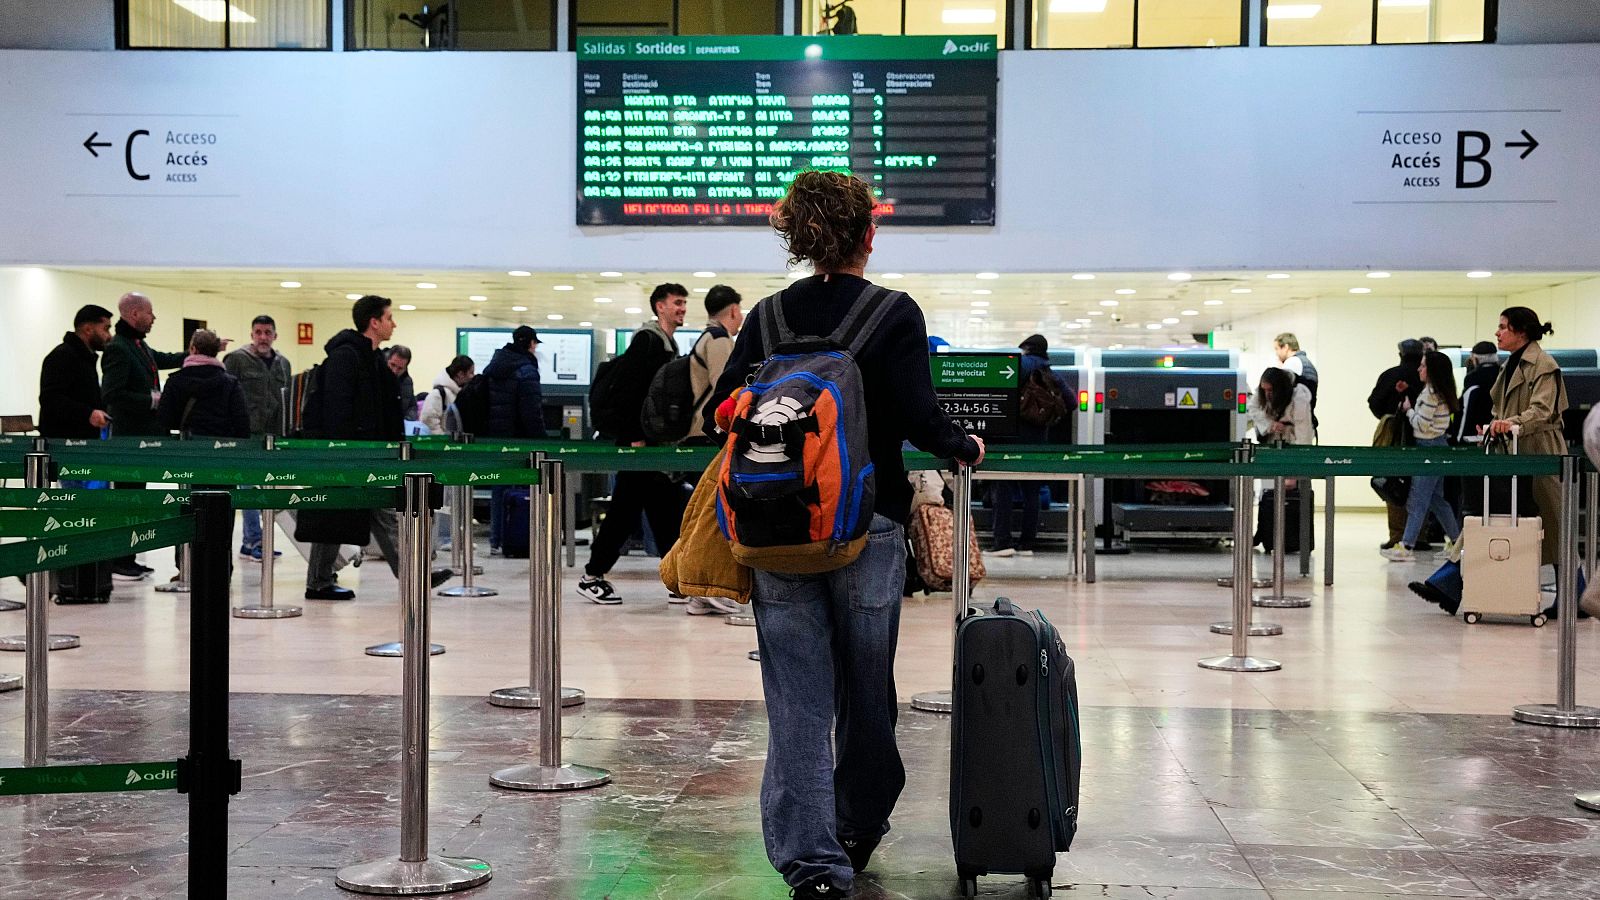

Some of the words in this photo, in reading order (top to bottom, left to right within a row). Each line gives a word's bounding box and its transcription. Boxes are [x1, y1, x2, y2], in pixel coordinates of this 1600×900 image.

[583, 42, 625, 54] Salidas
[635, 42, 686, 54] Sortides
[696, 46, 740, 54] DEPARTURES
[959, 42, 990, 52] adif
[622, 72, 648, 80] Destino
[756, 72, 770, 80] Tren
[886, 72, 935, 80] Observaciones
[622, 80, 659, 88] Destinació
[756, 80, 772, 88] Tren
[886, 80, 933, 88] Observacions
[166, 130, 217, 145] Acceso
[1382, 130, 1442, 145] Acceso
[125, 130, 150, 181] C
[166, 151, 208, 166] Accés
[1392, 152, 1441, 168] Accés
[1455, 130, 1492, 189] B
[166, 174, 198, 182] ACCESS
[1403, 176, 1440, 187] ACCESS
[52, 494, 77, 502] adif
[302, 494, 328, 502] adif
[62, 518, 97, 528] adif
[139, 528, 157, 542] adif
[48, 544, 69, 557] adif
[144, 769, 178, 781] adif
